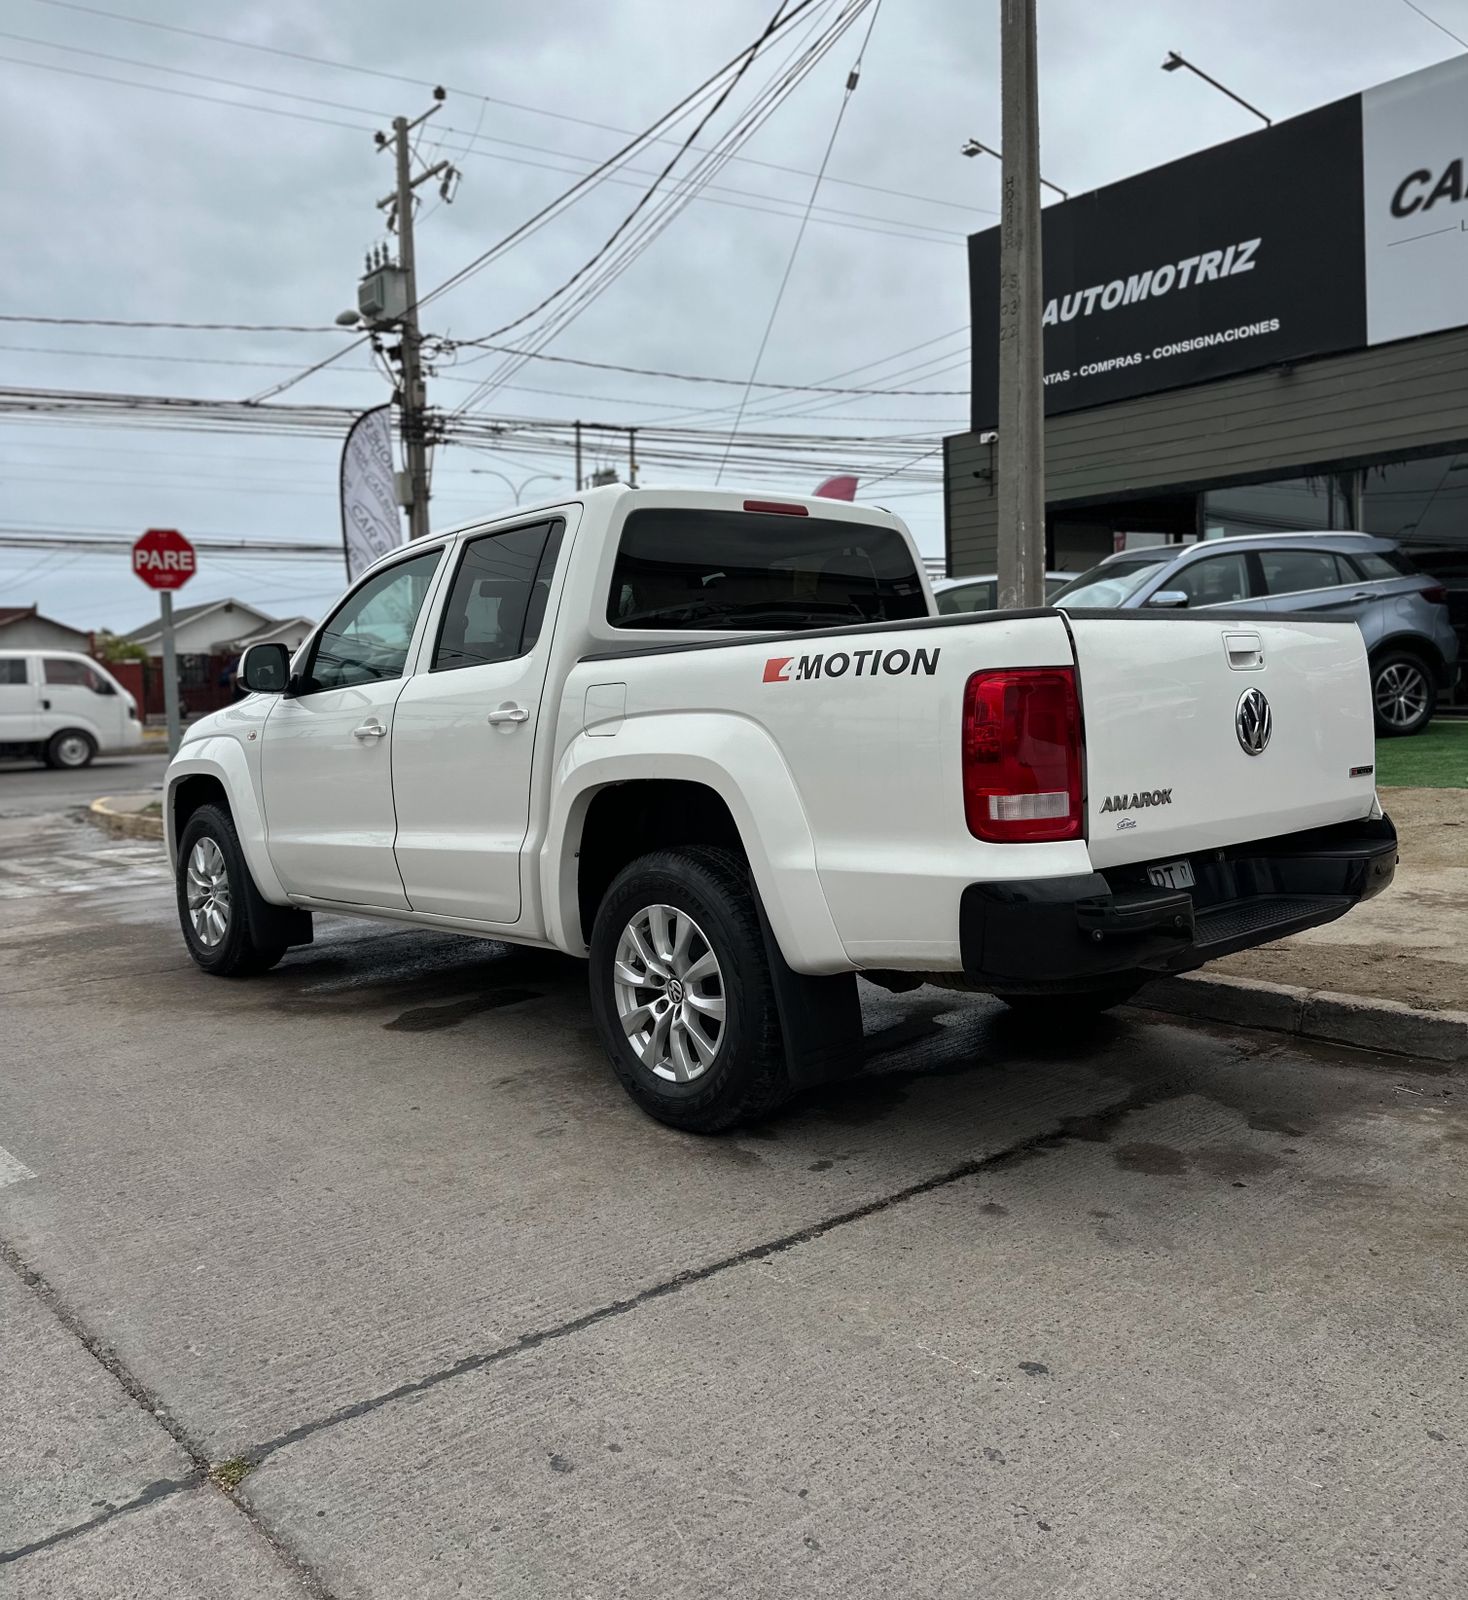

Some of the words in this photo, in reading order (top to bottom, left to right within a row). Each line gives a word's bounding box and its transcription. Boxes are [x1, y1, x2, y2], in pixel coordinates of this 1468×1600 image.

[1389, 157, 1468, 219] CA
[1042, 238, 1261, 328] AUTOMOTRIZ
[1080, 353, 1142, 377] COMPRAS
[1152, 318, 1280, 360] CONSIGNACIONES
[352, 504, 378, 539] CAR
[135, 549, 193, 571] PARE
[1099, 788, 1172, 814] AMAROK
